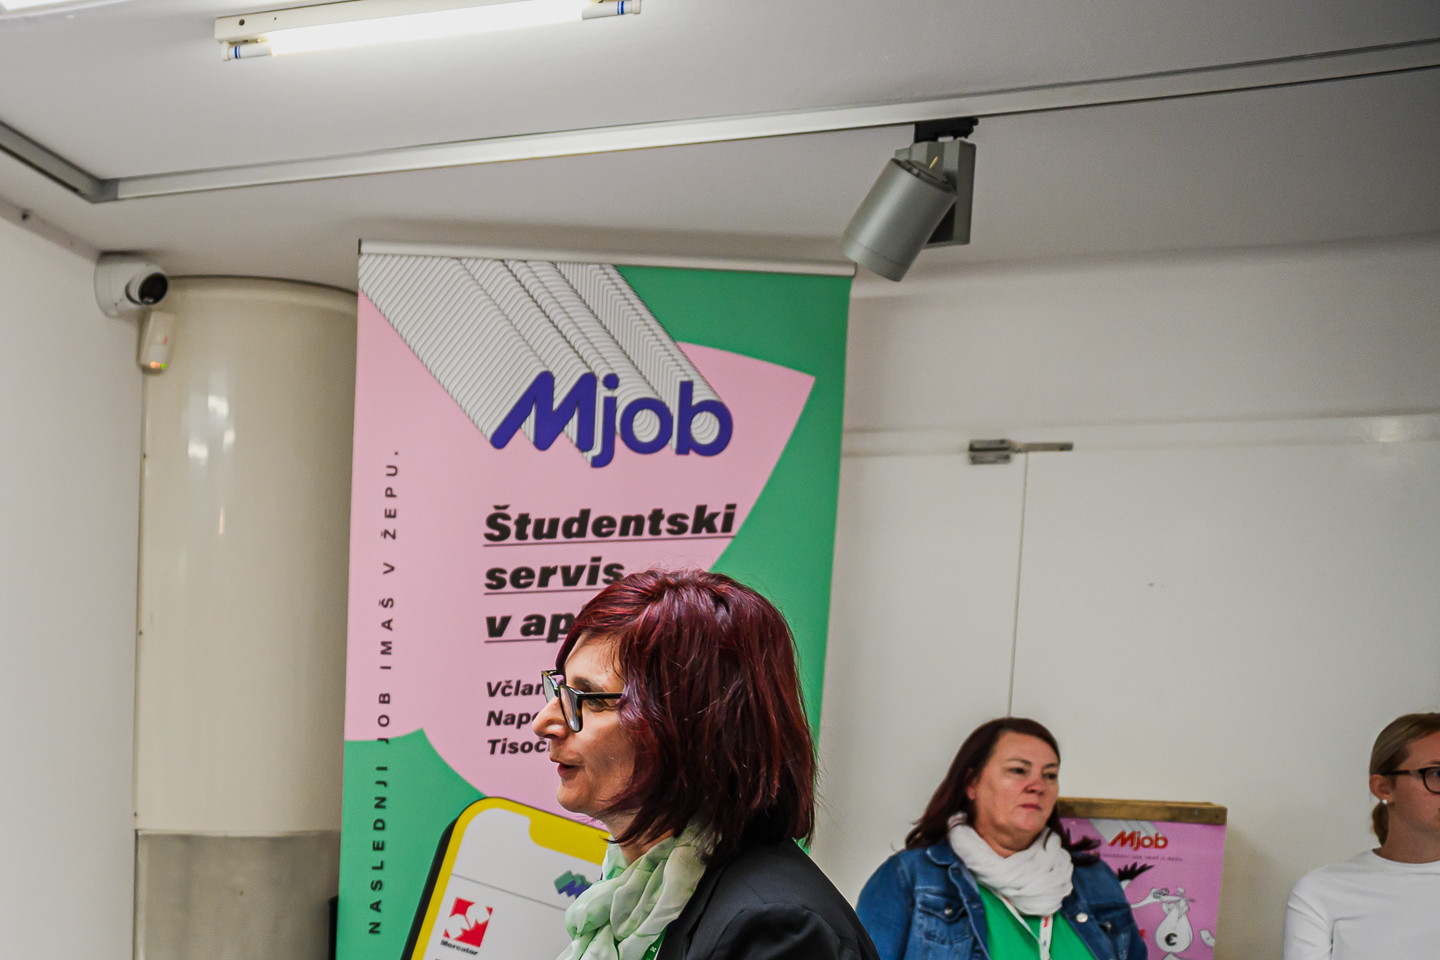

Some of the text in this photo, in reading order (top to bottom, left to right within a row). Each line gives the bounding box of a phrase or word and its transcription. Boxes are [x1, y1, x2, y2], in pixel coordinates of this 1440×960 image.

[490, 370, 733, 468] Mjob
[483, 503, 737, 542] Študentski
[484, 556, 625, 590] servis
[486, 612, 576, 643] v ap
[368, 451, 399, 934] NASLEDNJI JOB IMAŠ V ŽEPU.
[1110, 831, 1169, 850] Mjob
[440, 939, 479, 956] Mercator
